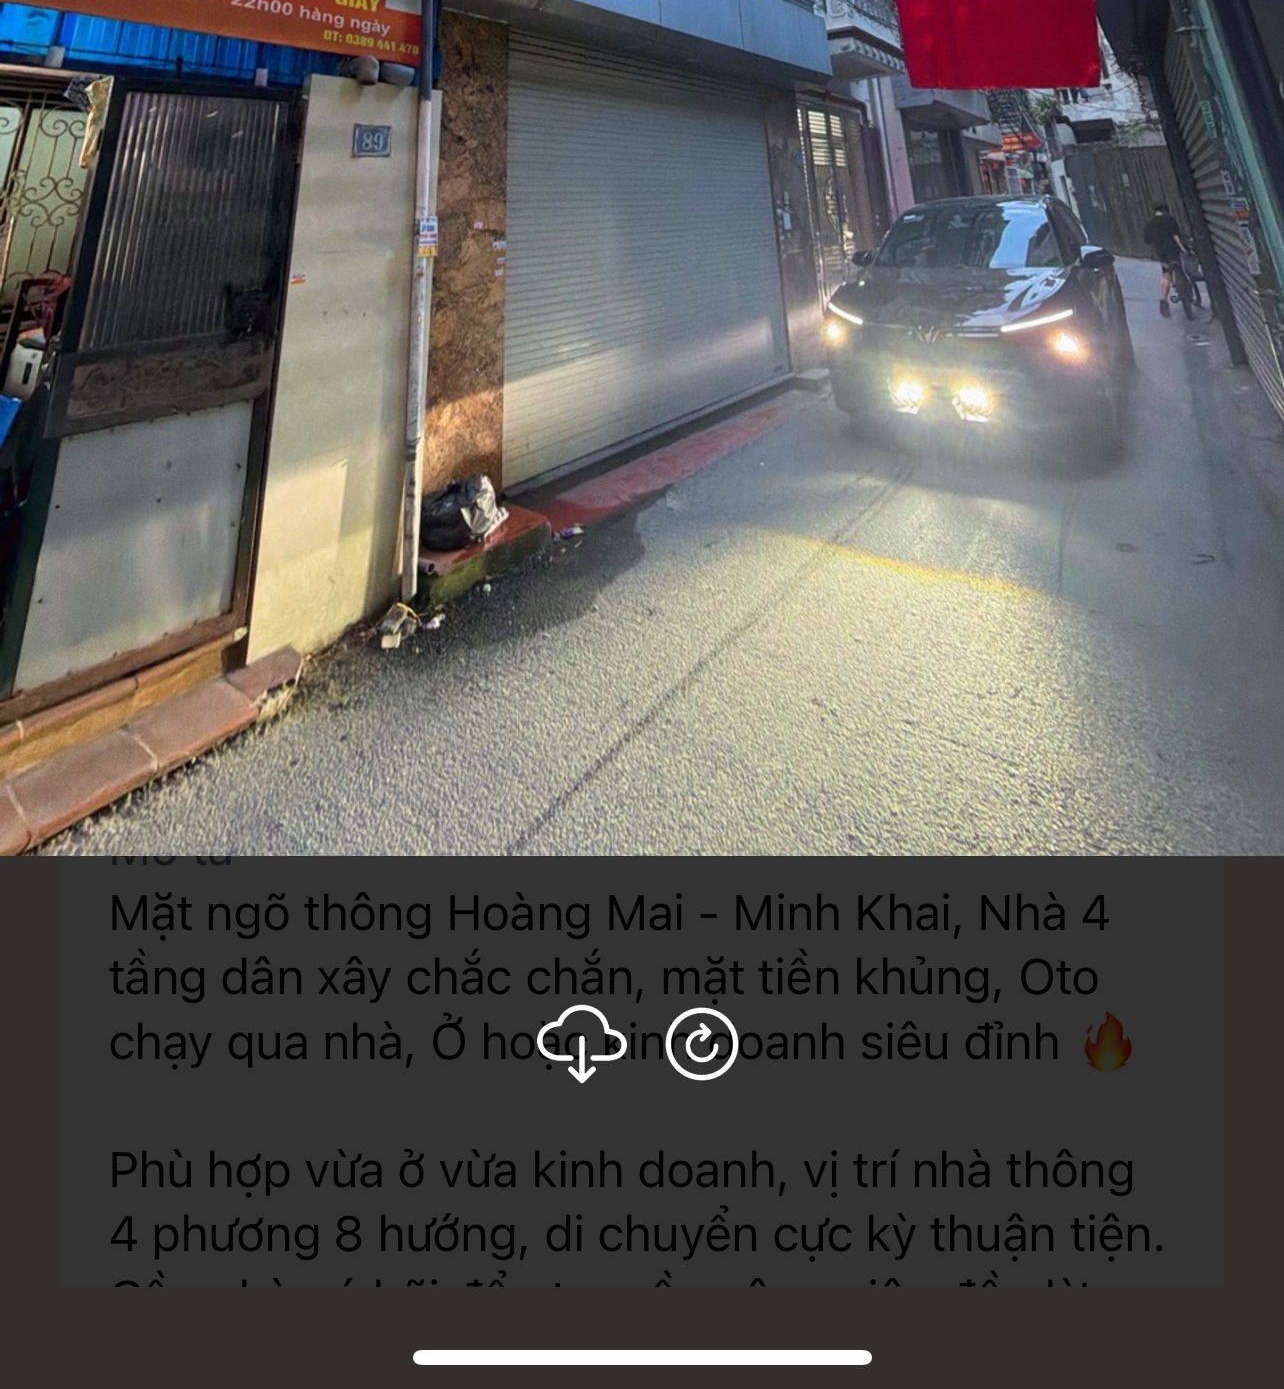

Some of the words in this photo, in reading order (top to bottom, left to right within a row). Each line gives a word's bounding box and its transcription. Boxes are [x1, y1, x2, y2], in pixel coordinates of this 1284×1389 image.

[299, 4, 345, 28] hàng
[350, 19, 391, 37] ngày
[362, 132, 384, 151] 89
